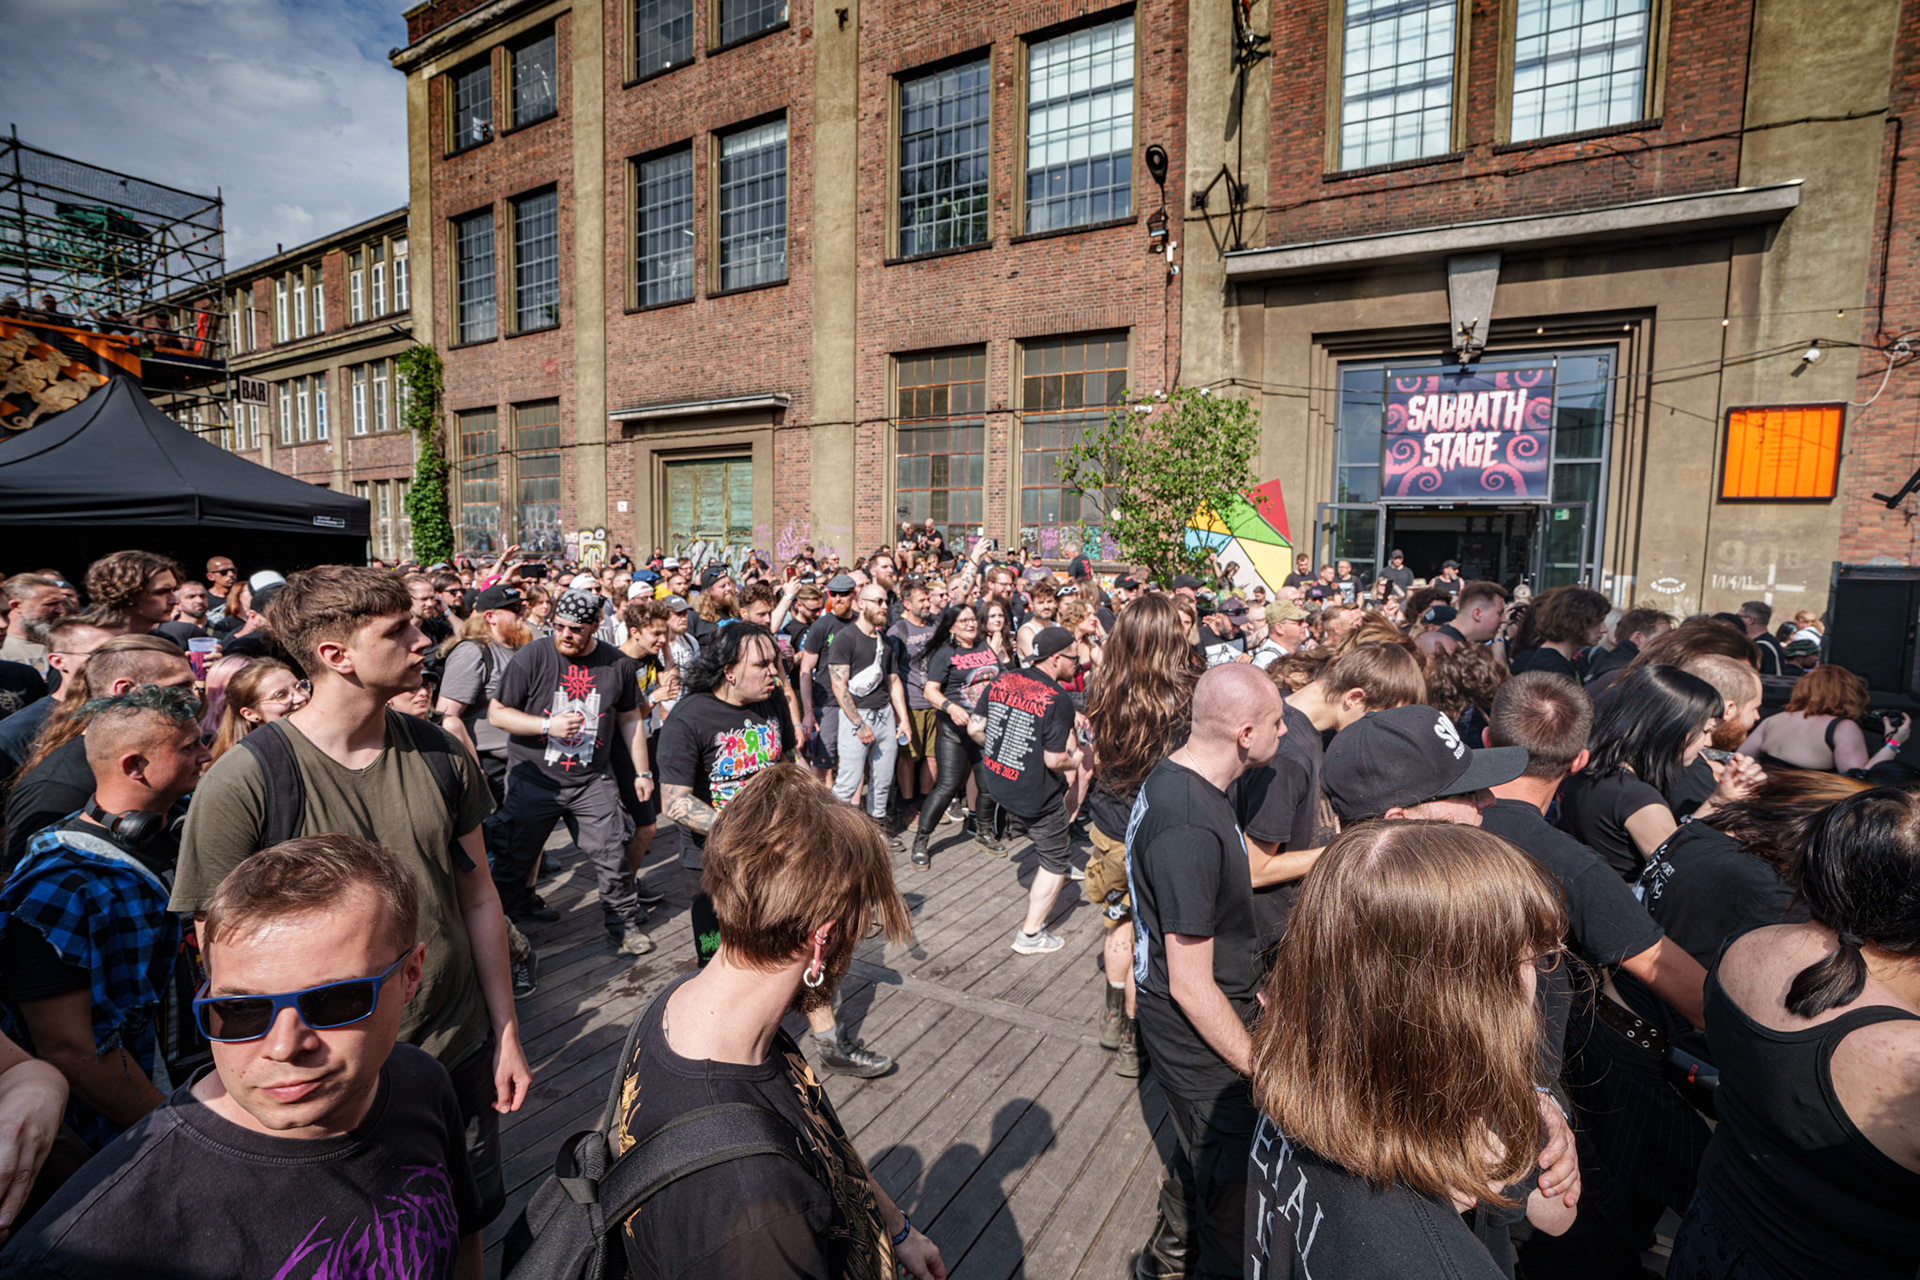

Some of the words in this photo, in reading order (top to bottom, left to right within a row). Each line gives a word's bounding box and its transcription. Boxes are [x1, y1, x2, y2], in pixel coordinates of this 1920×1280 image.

[242, 380, 266, 402] BAR
[1406, 388, 1528, 435] SABBATH
[1422, 431, 1501, 472] STAGE
[1005, 692, 1046, 718] REMAINS
[1001, 763, 1020, 781] 2023
